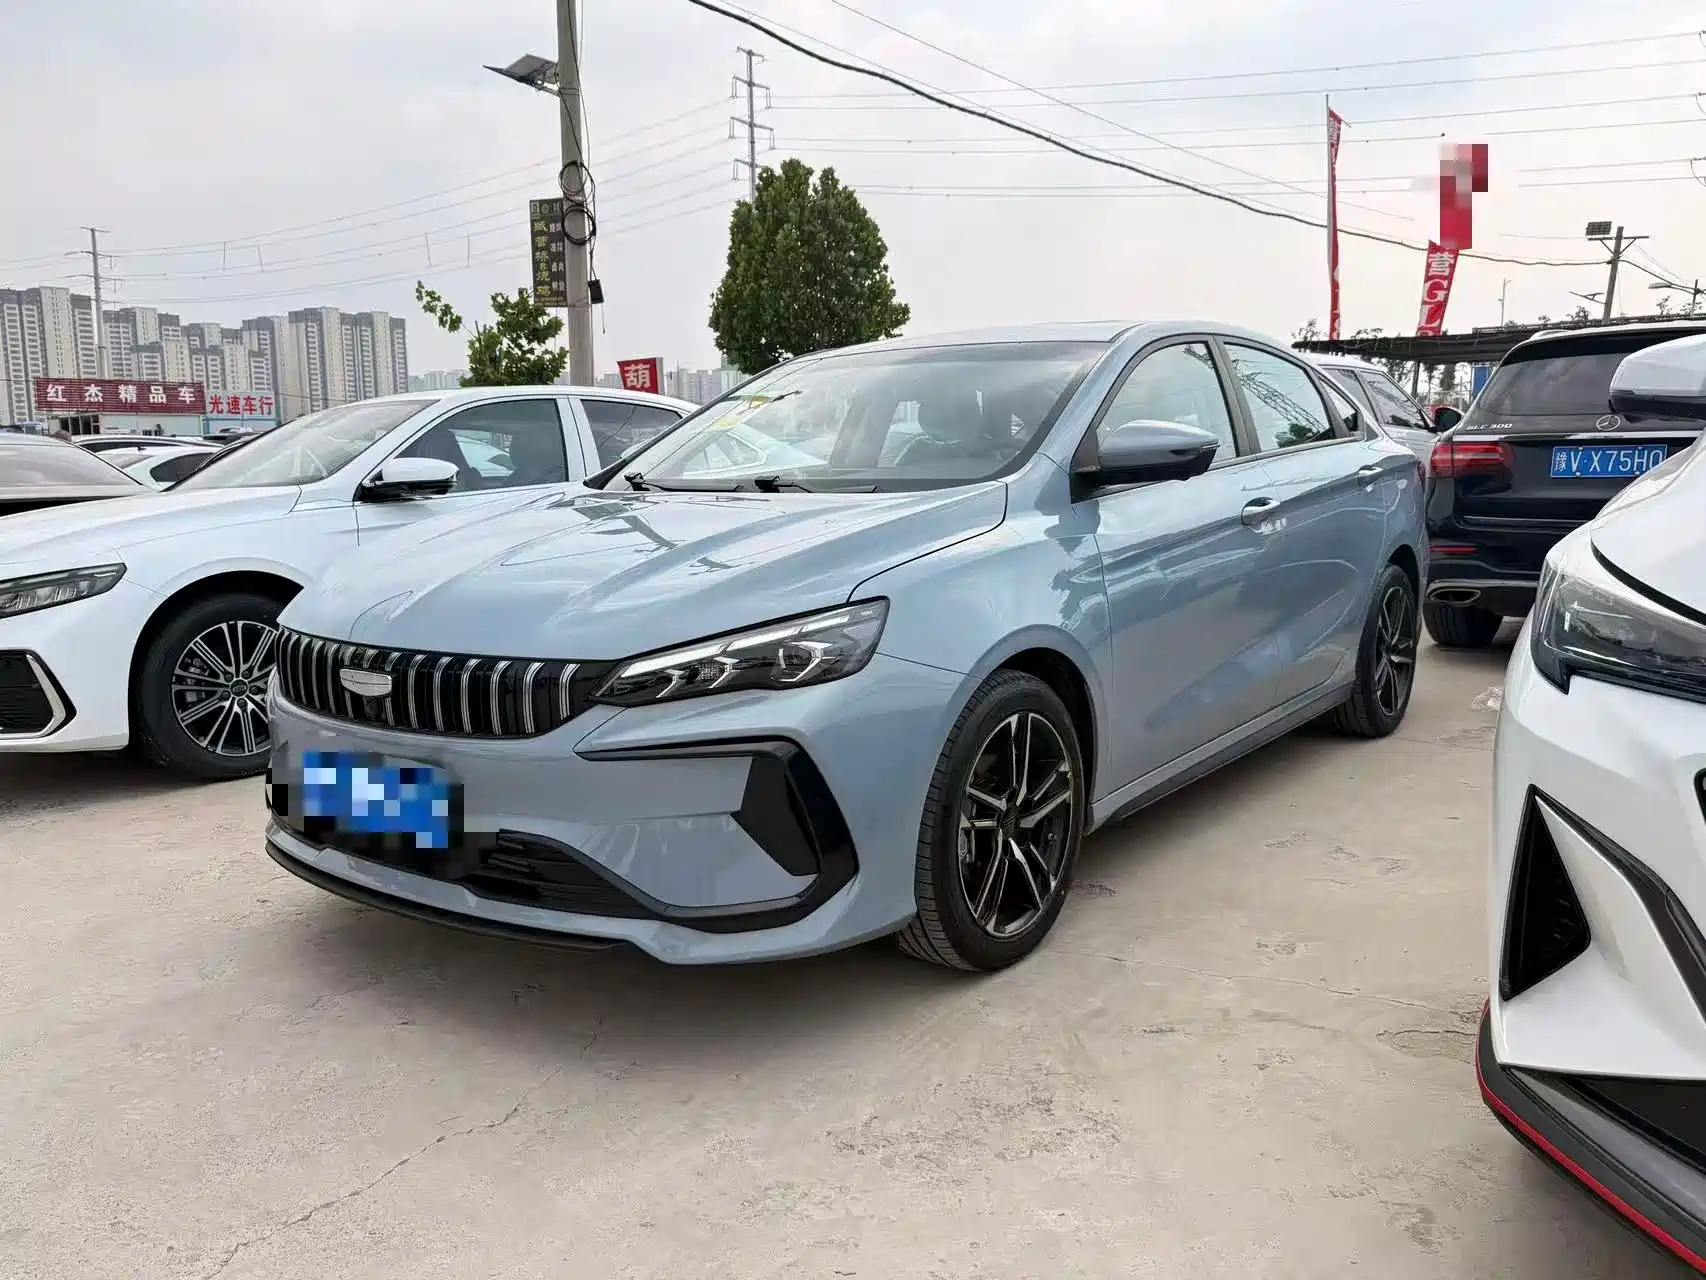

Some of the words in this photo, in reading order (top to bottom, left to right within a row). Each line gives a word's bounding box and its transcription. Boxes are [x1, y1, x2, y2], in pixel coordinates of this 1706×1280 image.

[47, 383, 196, 405] 红杰精品车
[209, 394, 273, 416] 光速车行
